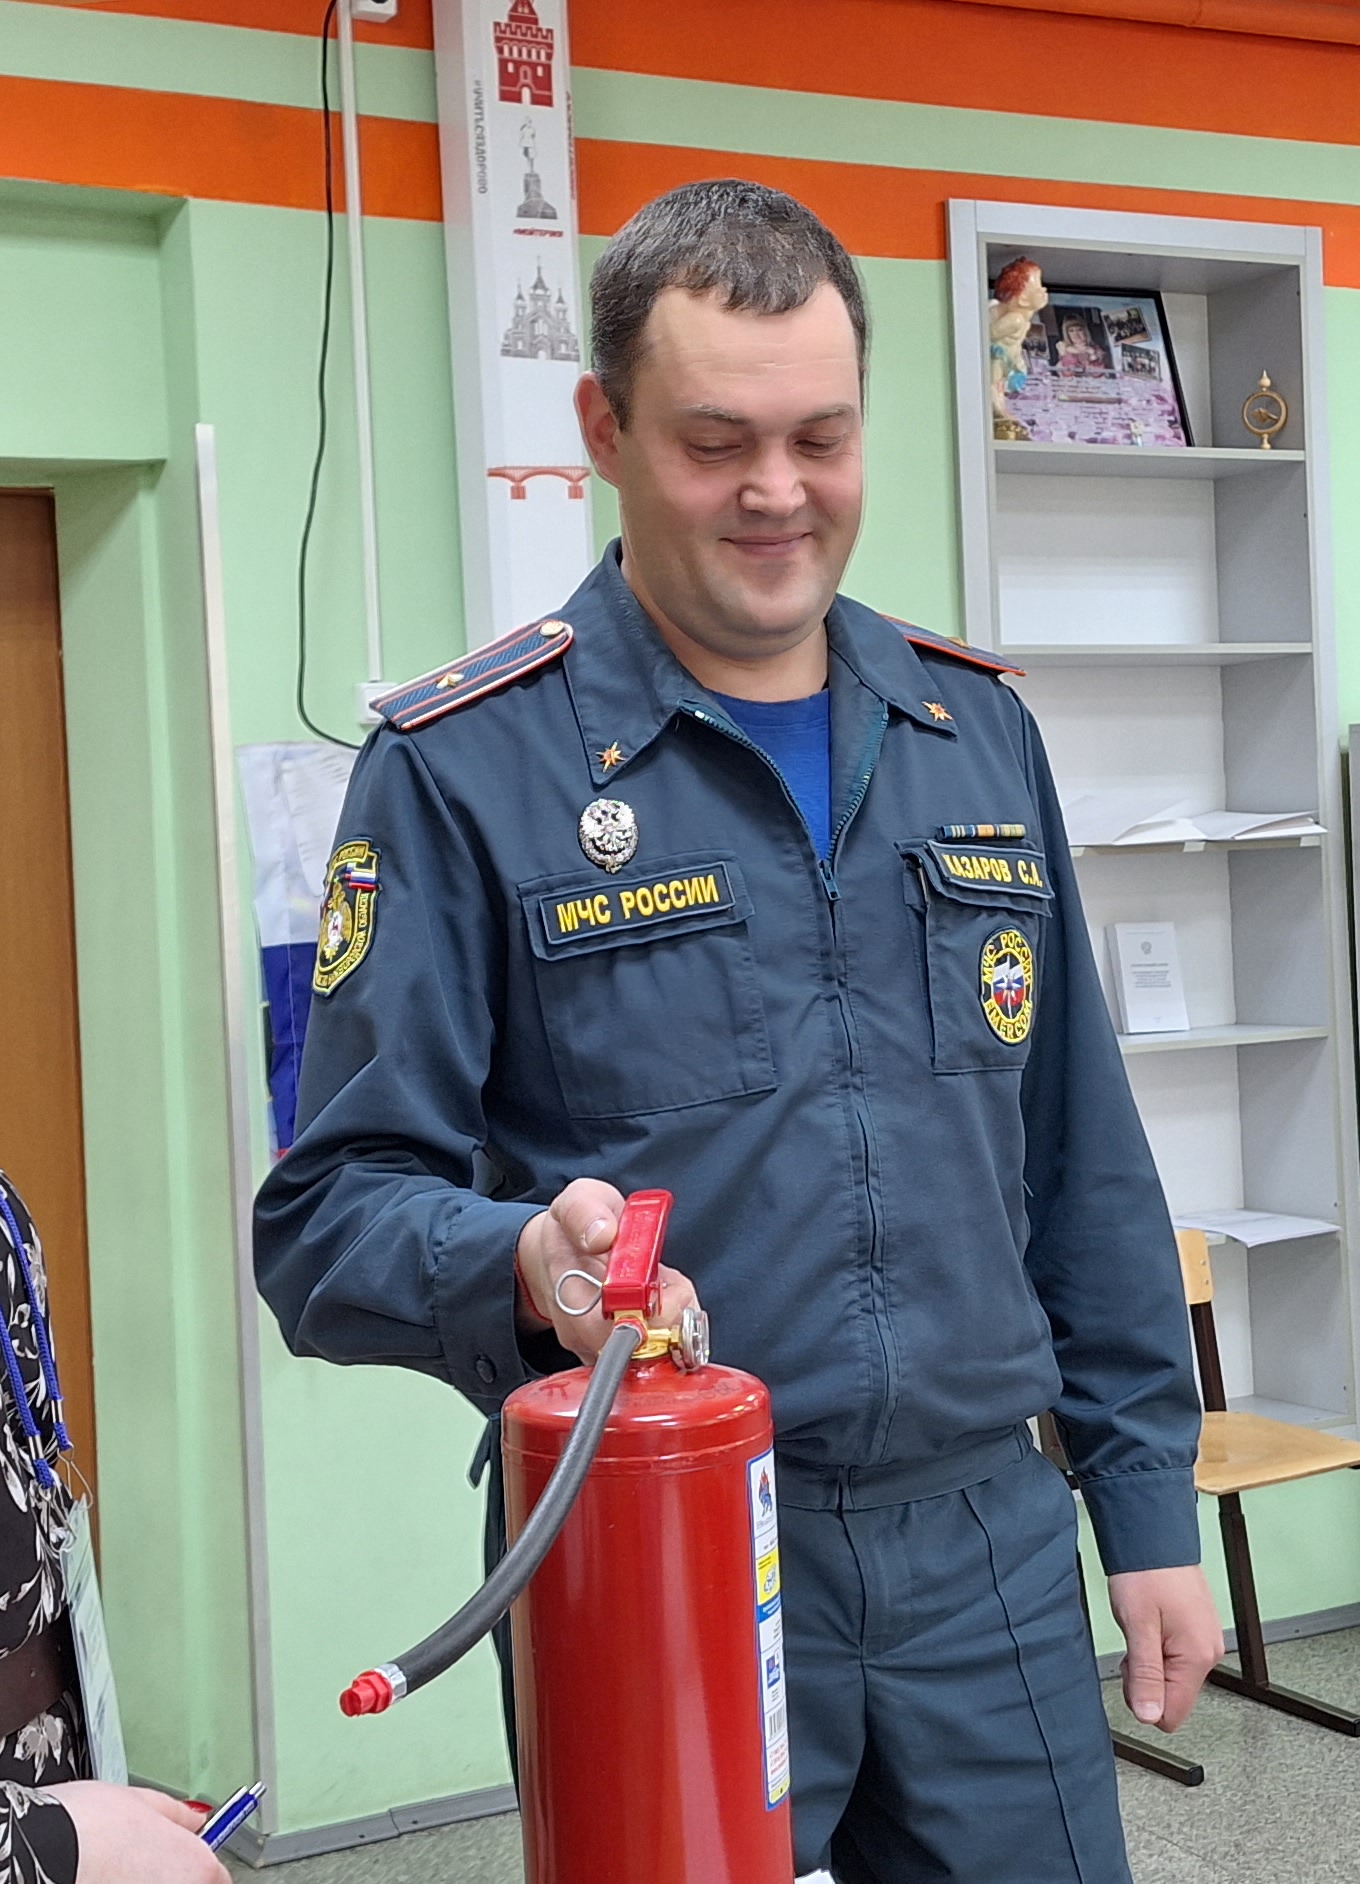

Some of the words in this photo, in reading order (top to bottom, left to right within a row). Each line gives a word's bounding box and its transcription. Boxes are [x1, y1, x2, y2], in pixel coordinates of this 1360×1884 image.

[556, 894, 611, 933] МЧС
[619, 874, 720, 919] РОССИИ
[982, 944, 997, 985] МЧС
[1000, 932, 1033, 986] РОССИИ
[983, 999, 1033, 1039] EMERCOM
